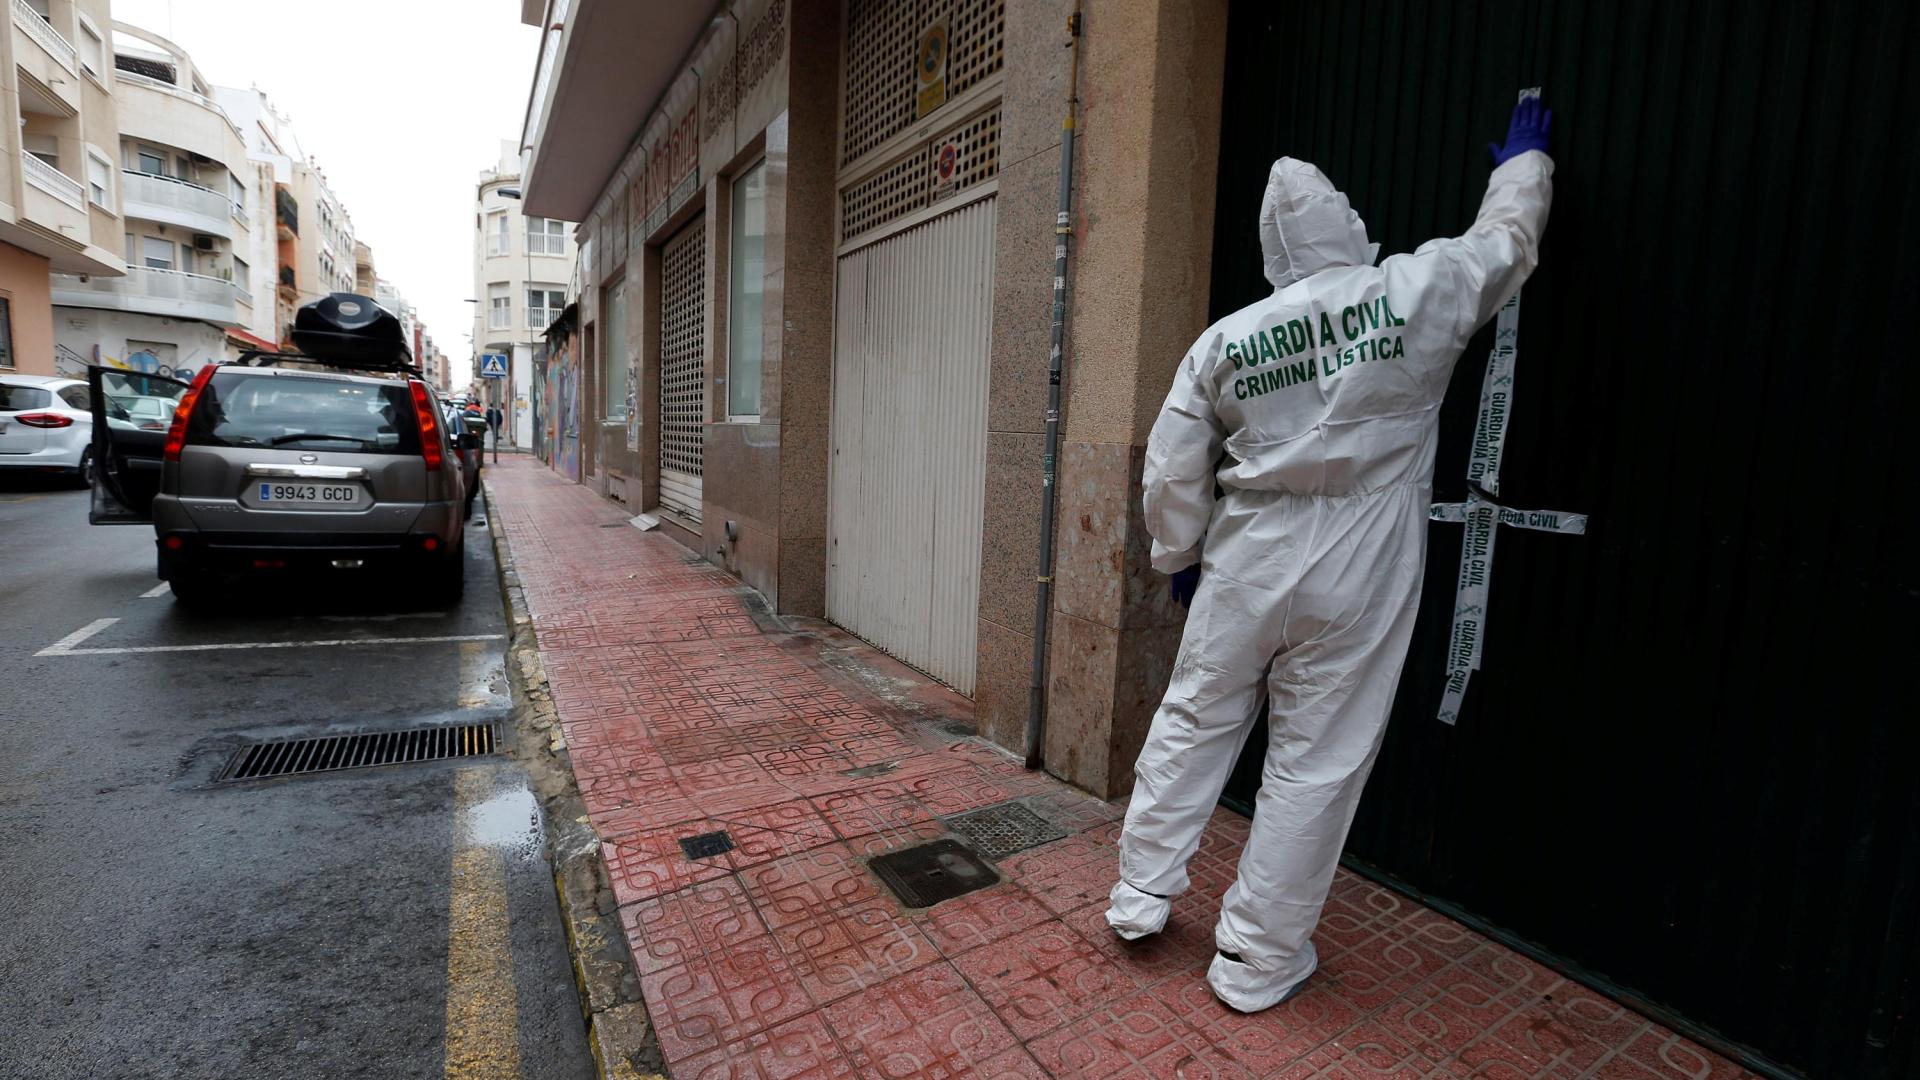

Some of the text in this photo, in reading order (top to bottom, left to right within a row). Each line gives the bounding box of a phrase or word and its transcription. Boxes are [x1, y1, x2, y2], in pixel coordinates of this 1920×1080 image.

[1225, 295, 1406, 371] GUARDIA CIVIL
[1488, 392, 1506, 442] GUARDIA
[1470, 462, 1486, 480] CIV
[274, 485, 353, 502] 9943 GCD
[1529, 513, 1561, 529] CIVIL
[1469, 507, 1493, 587] GUARDIA CIVIL
[1457, 620, 1477, 667] GUARDIA
[1447, 669, 1467, 694] CIVIL
